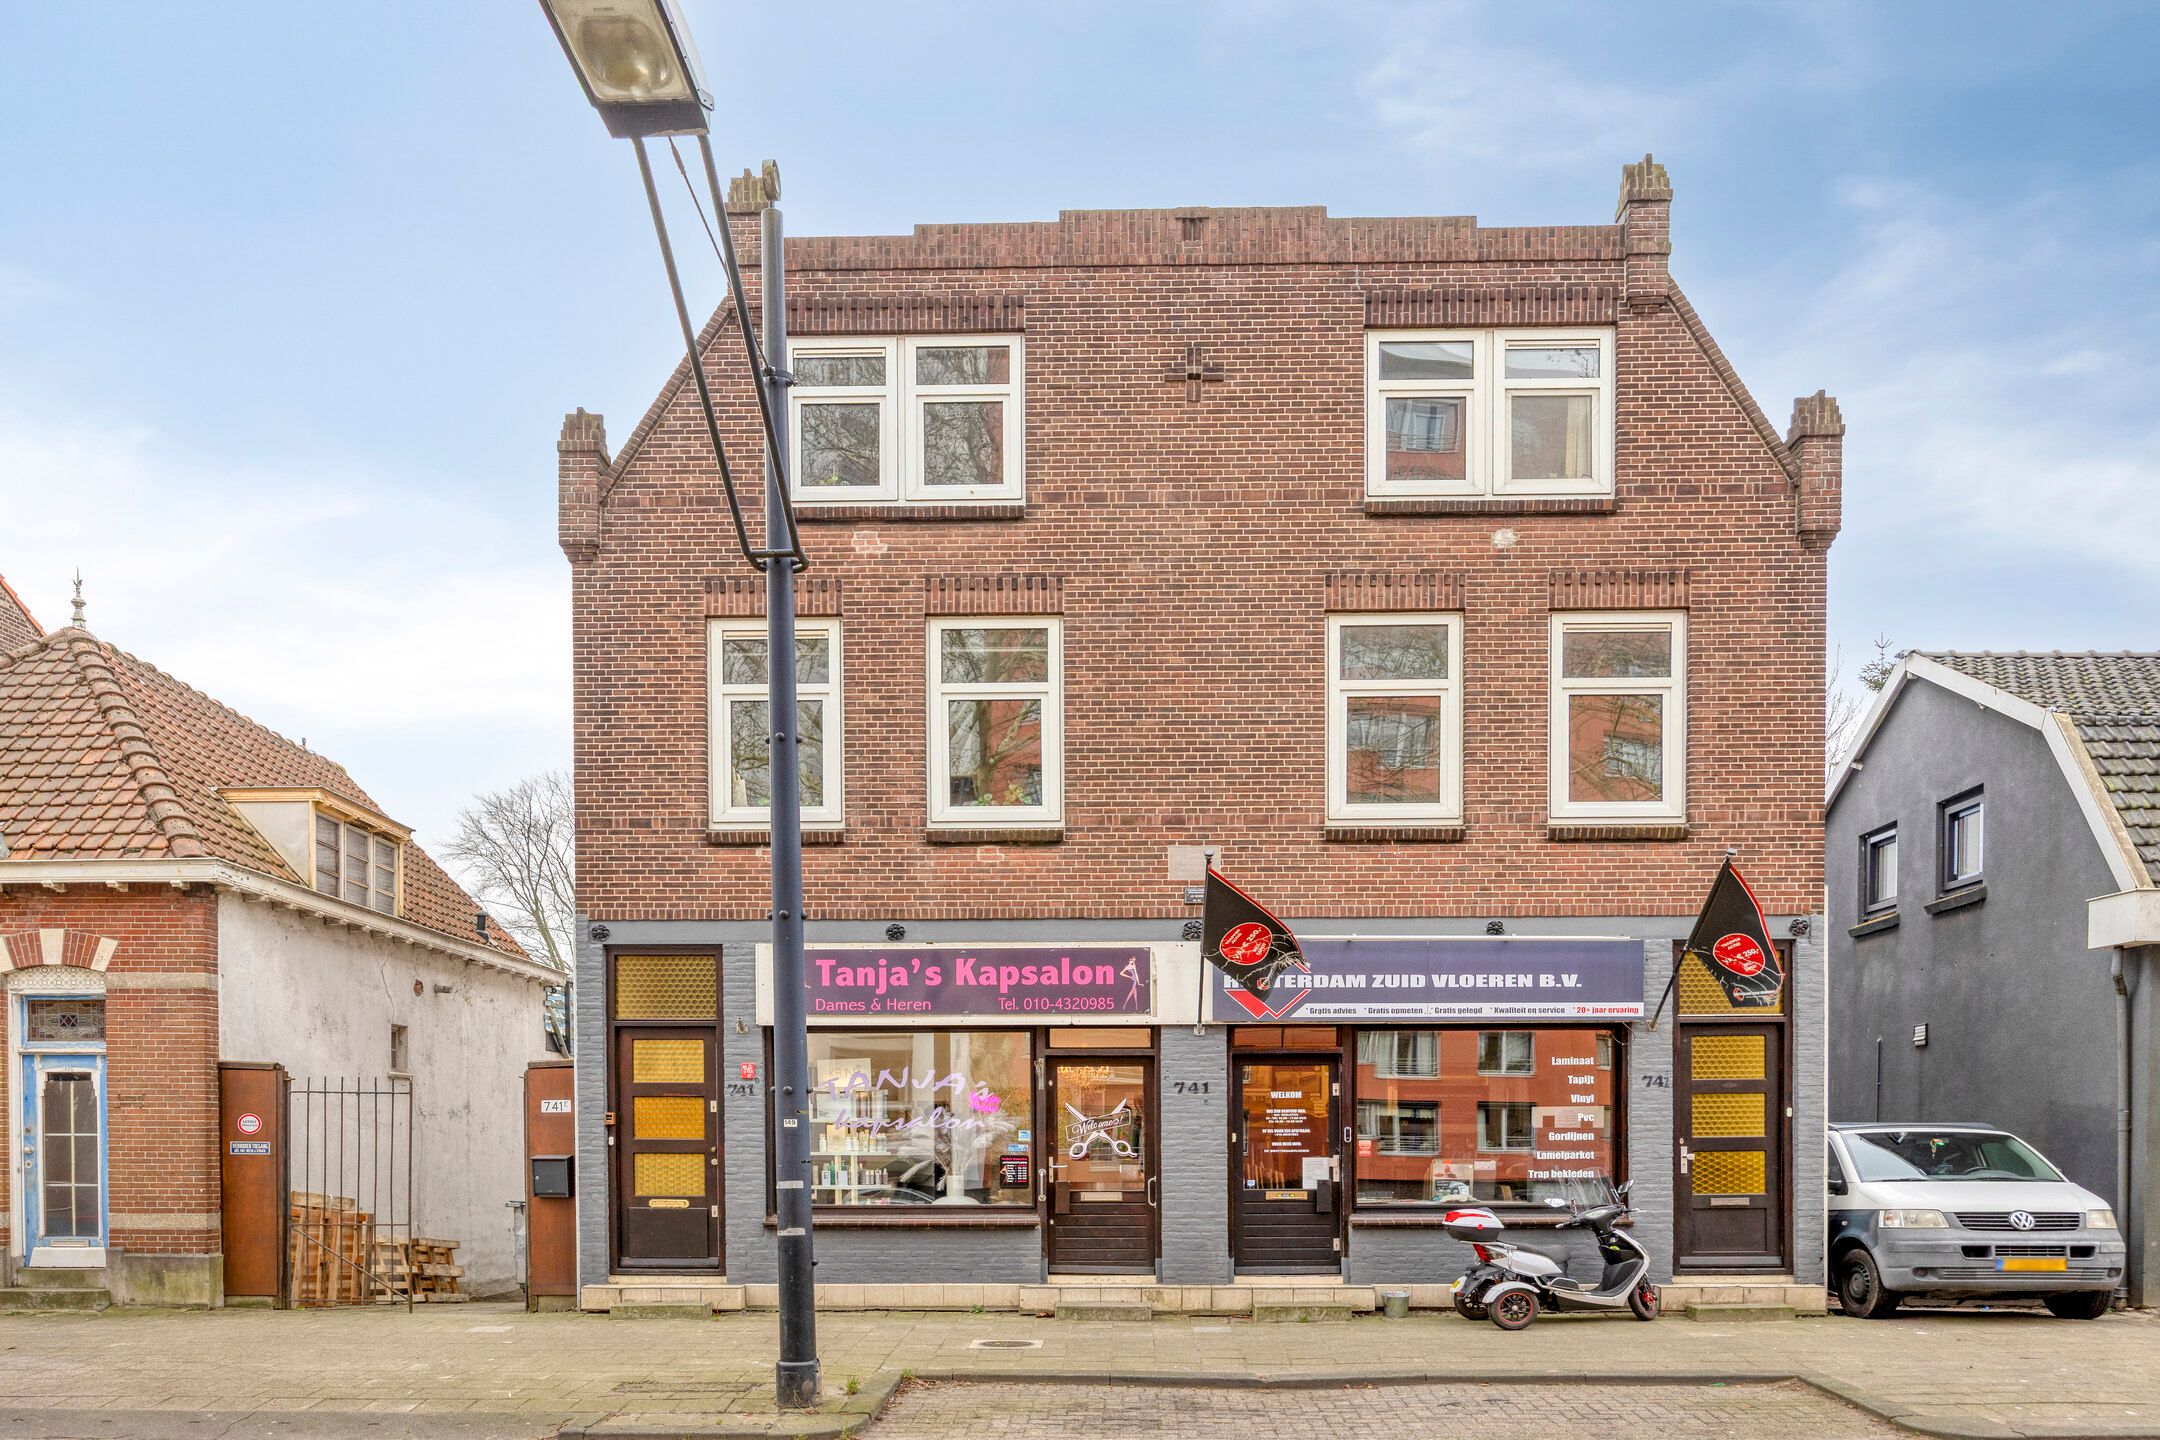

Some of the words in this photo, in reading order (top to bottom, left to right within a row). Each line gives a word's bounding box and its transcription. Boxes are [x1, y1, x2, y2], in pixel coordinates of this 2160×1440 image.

[815, 957, 943, 995] Tanja's
[955, 957, 1115, 993] Kapsalon
[1371, 974, 1426, 988] ZUID
[1431, 974, 1533, 988] VLOEREN
[1539, 974, 1582, 988] B.V.
[815, 998, 866, 1011] Dames
[870, 998, 881, 1011] &
[886, 998, 932, 1011] Heren
[998, 997, 1020, 1010] Tel.
[1023, 997, 1115, 1010] 010-4320985
[1309, 1007, 1331, 1015] Gratis
[1332, 1007, 1357, 1015] advies
[1368, 1007, 1390, 1015] Gratis
[1391, 1007, 1423, 1015] opmeten
[1434, 1007, 1456, 1015] Gratis
[1457, 1007, 1483, 1015] gelegd
[1494, 1006, 1527, 1014] Kwaliteit
[1527, 1006, 1537, 1014] en
[1538, 1006, 1565, 1014] service
[1576, 1006, 1590, 1014] 20+
[1592, 1006, 1607, 1014] jaar
[1608, 1006, 1639, 1014] ervaring
[1551, 1056, 1594, 1065] Laminaat
[1567, 1075, 1594, 1085] Tapijt
[727, 1084, 755, 1096] 741
[1173, 1081, 1210, 1094] 741
[1570, 1094, 1594, 1103] Vinyl
[1577, 1113, 1594, 1121] Pvc
[1548, 1132, 1594, 1141] Gordijnen
[1536, 1151, 1595, 1160] Lamelparket
[1528, 1170, 1549, 1179] Trap
[1551, 1169, 1594, 1178] bekleden
